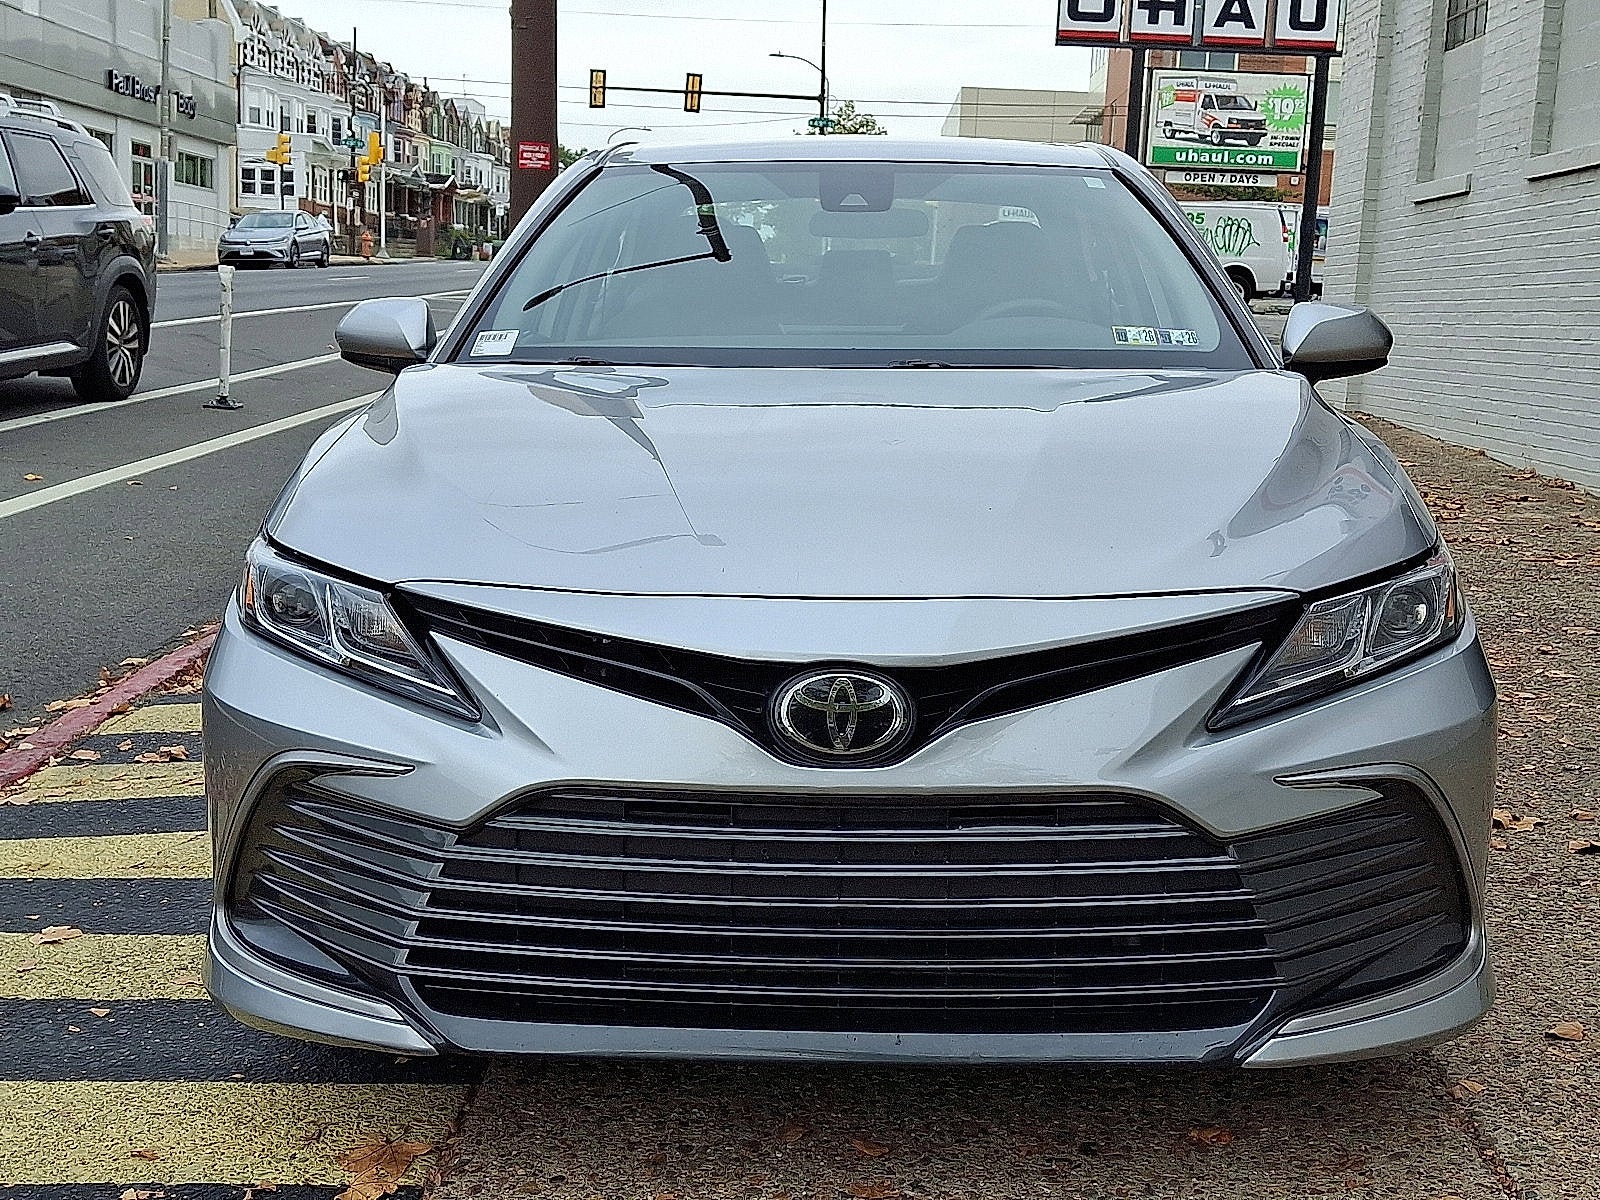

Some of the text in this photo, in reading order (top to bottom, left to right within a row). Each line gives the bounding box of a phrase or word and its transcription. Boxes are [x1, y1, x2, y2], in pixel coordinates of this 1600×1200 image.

[107, 69, 134, 97] Paul
[1175, 149, 1273, 165] uhaul.com
[1184, 172, 1259, 185] OPEN 7 DAYS
[1142, 329, 1155, 342] 26
[1184, 331, 1198, 344] 26
